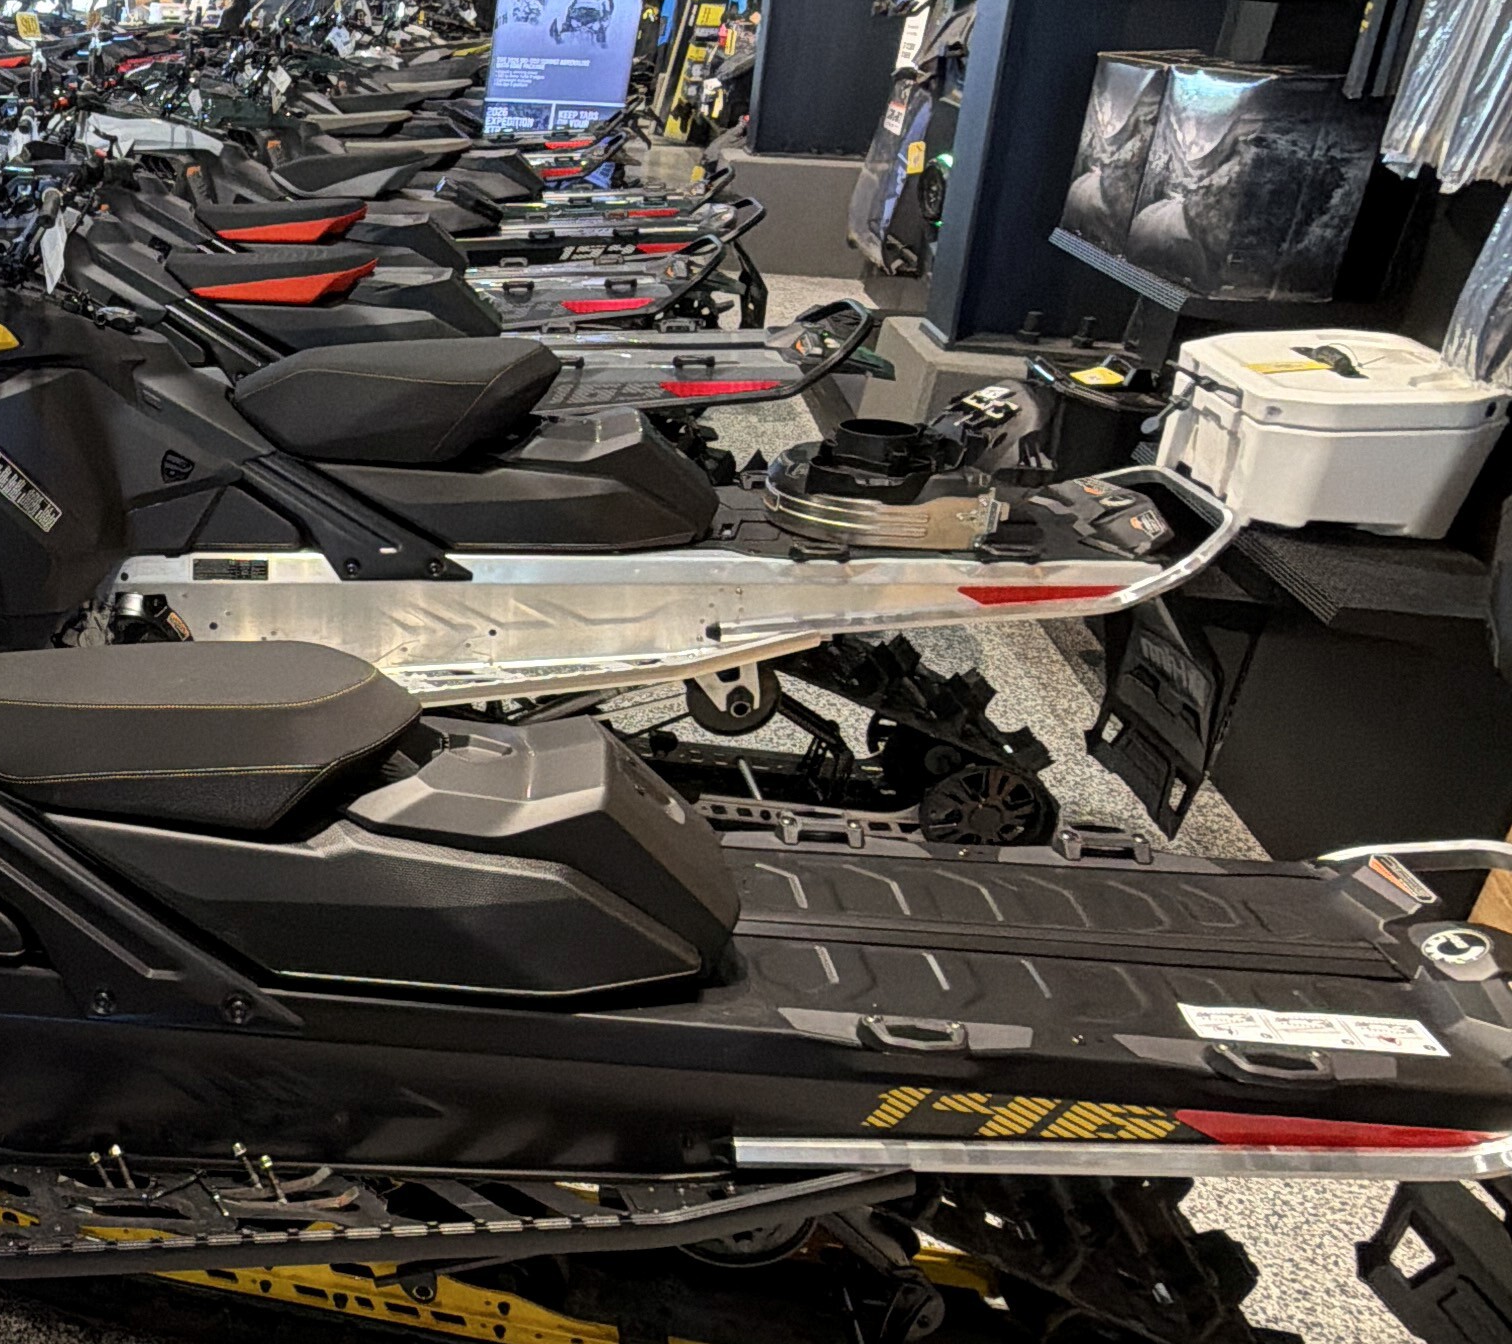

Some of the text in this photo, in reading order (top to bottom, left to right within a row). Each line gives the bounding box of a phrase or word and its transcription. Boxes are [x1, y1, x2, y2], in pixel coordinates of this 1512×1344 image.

[487, 106, 509, 117] 2026
[558, 110, 579, 120] KEEP
[486, 116, 535, 129] EXPEDITION
[860, 1086, 1181, 1140] 146
